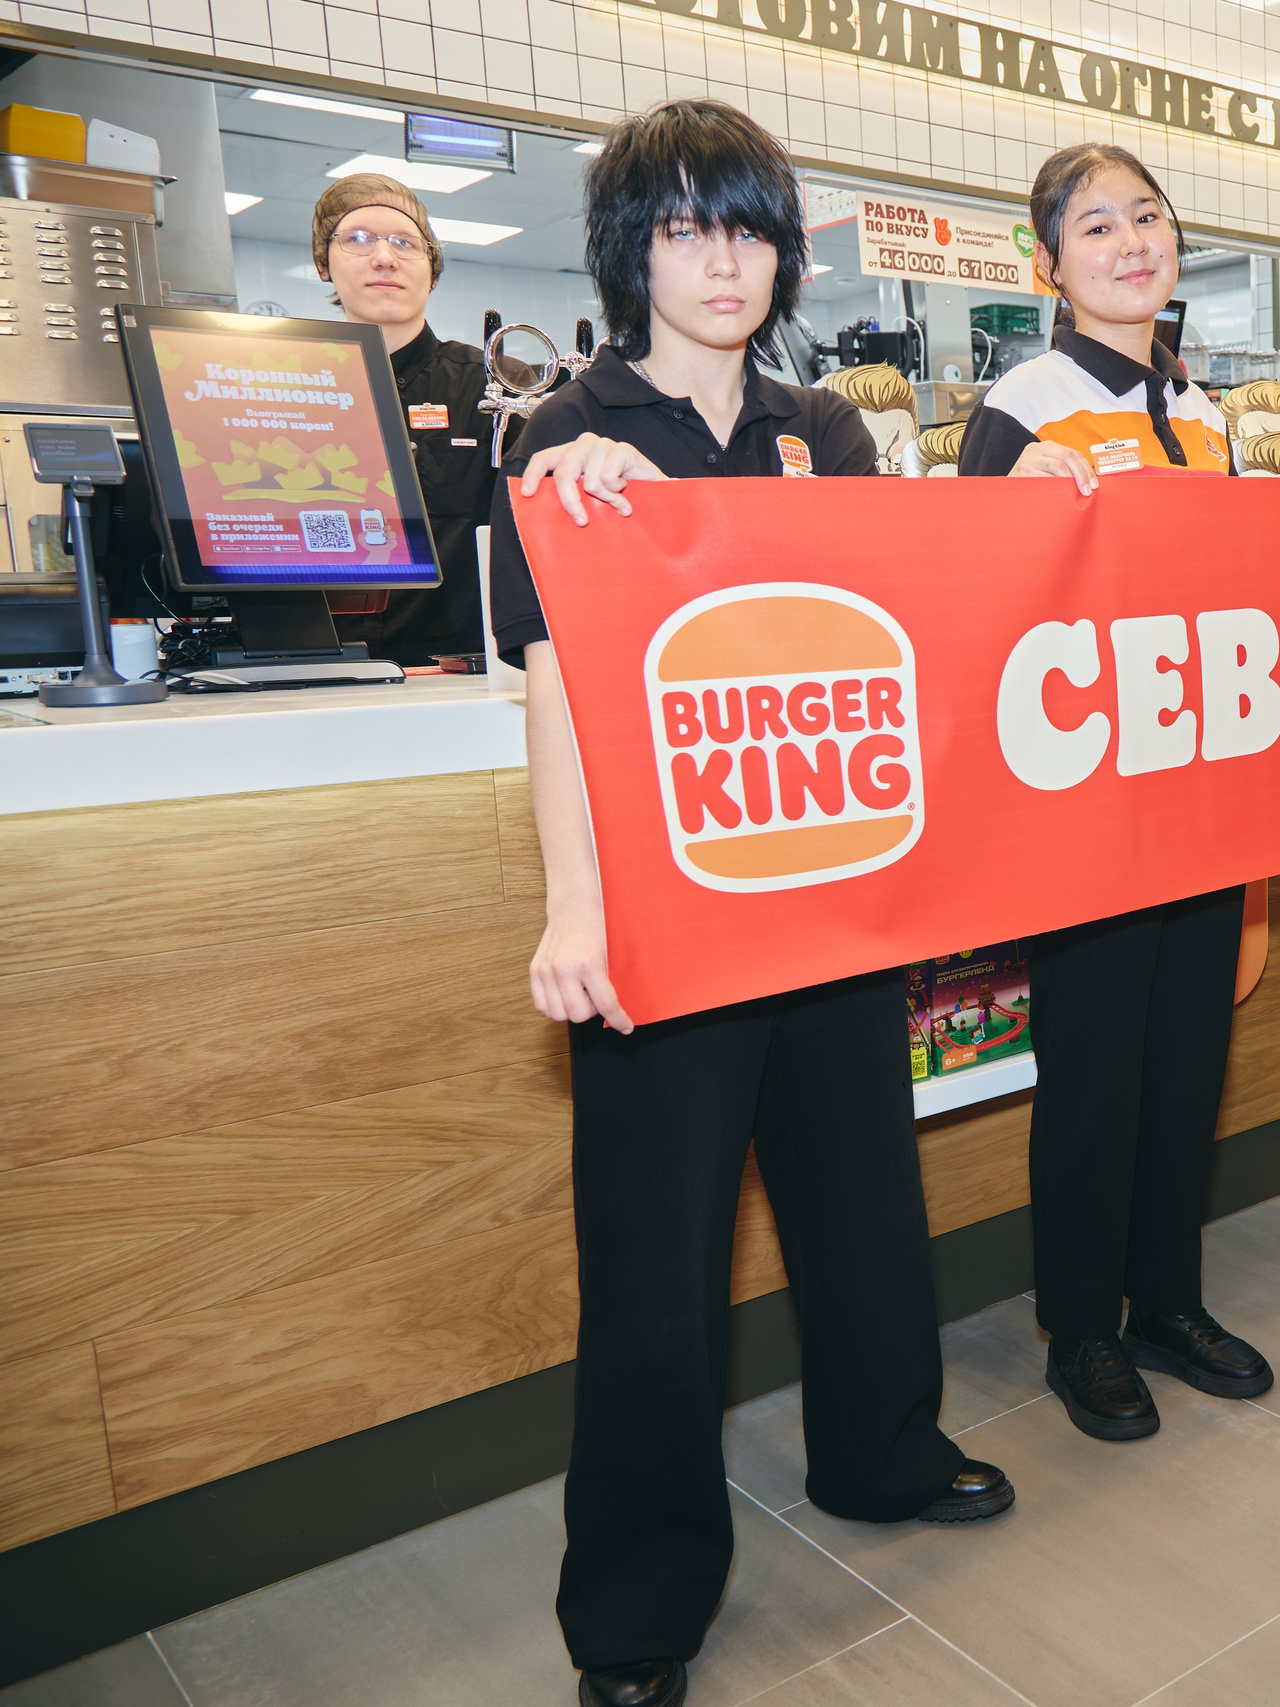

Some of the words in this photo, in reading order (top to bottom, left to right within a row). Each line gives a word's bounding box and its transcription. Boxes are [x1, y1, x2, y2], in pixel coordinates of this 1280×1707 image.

[979, 27, 1066, 101] НА
[1080, 50, 1217, 137] ОГНЕ
[1228, 92, 1260, 143] С
[864, 201, 928, 225] РАБОТА
[865, 220, 883, 233] ПО
[887, 222, 929, 239] ВКУСУ
[956, 227, 1009, 241] Присоединяйся
[866, 237, 907, 248] Зарабатывай:
[963, 239, 994, 248] команде!
[868, 260, 878, 268] от
[880, 250, 904, 268] 46
[908, 253, 944, 274] 000
[948, 270, 957, 278] до
[960, 260, 981, 278] 67
[985, 263, 1018, 283] 000
[204, 363, 337, 388] Коронный
[184, 380, 355, 411] Миллионер
[246, 408, 306, 420] Выигрывай
[223, 417, 230, 427] 1
[232, 417, 262, 428] 000
[264, 419, 288, 430] 000
[291, 422, 335, 433] корон!
[780, 444, 808, 456] BURGER
[782, 450, 809, 465] KING
[205, 512, 275, 523] Заказывай
[208, 522, 231, 532] без
[233, 523, 284, 534] очереди
[211, 533, 219, 541] в
[221, 532, 300, 543] приложении
[661, 676, 906, 749] BURGER
[670, 733, 912, 835] KING
[936, 966, 995, 985] БУРГЕРЛЕНД
[945, 1058, 956, 1066] 6+
